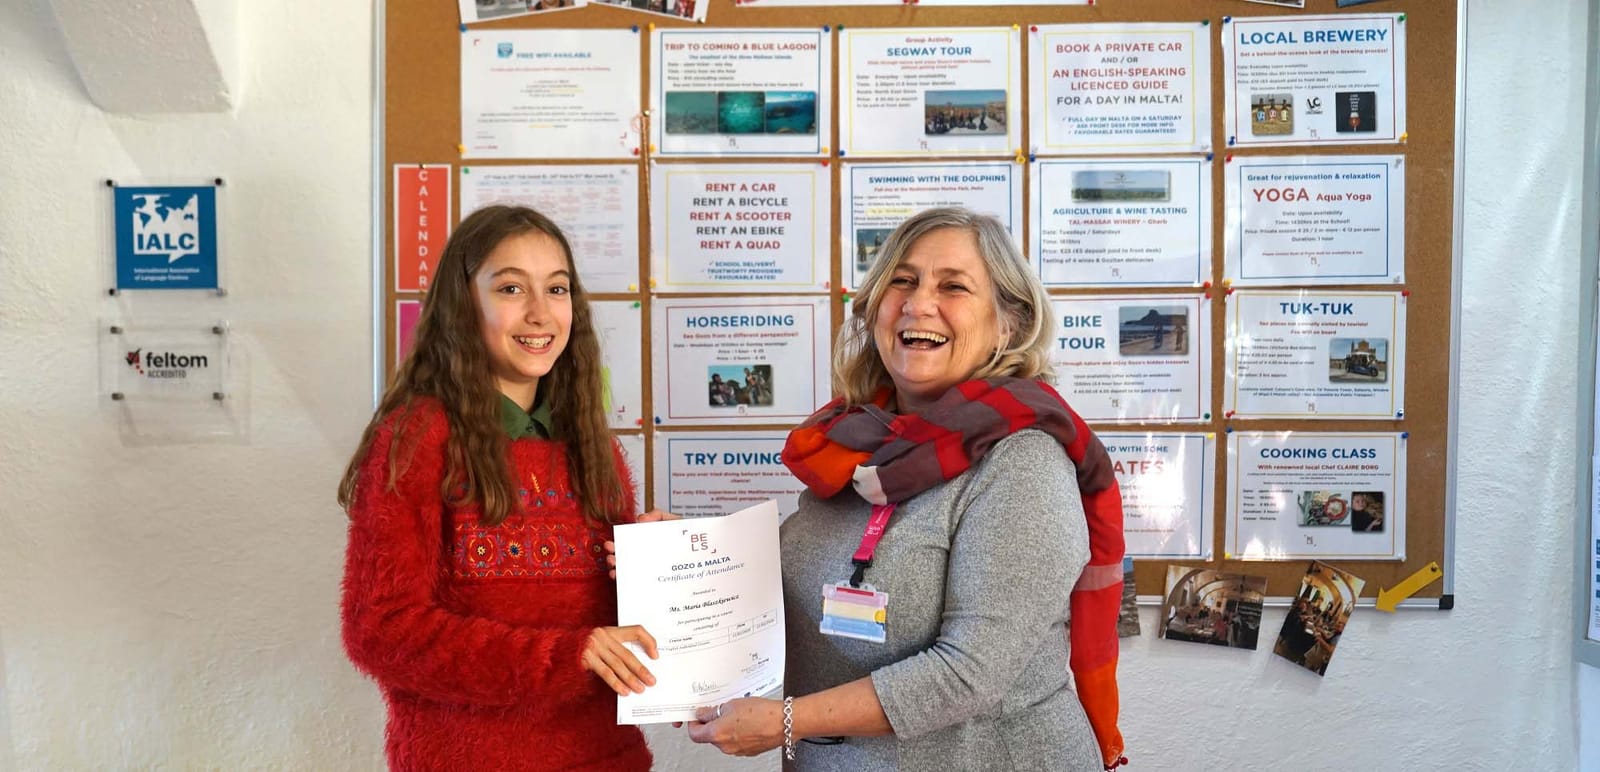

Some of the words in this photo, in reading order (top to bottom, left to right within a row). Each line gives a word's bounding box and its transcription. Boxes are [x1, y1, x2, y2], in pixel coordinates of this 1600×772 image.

[1240, 30, 1298, 45] LOCAL
[1304, 28, 1388, 44] BREWERY
[887, 47, 936, 57] SEGWAY
[941, 46, 972, 56] TOUR
[1056, 44, 1090, 53] BOOK
[1094, 43, 1102, 53] A
[1106, 43, 1155, 52] PRIVATE
[1158, 42, 1182, 52] CAR
[1053, 69, 1070, 78] AN
[1073, 67, 1186, 78] ENGLISH-SPEAKING
[1071, 80, 1128, 91] LICENCED
[1132, 80, 1168, 90] GUIDE
[1057, 96, 1080, 106] FOR
[1085, 96, 1092, 105] A
[1096, 95, 1120, 105] DAY
[1124, 95, 1135, 105] IN
[1140, 94, 1183, 104] MALTA!
[869, 176, 915, 184] SWIMMING
[943, 175, 960, 183] THE
[1247, 174, 1268, 182] Great
[1284, 173, 1332, 181] rejuvenation
[1335, 173, 1340, 181] &
[705, 183, 736, 192] RENT
[740, 183, 748, 192] A
[751, 183, 776, 192] CAR
[1253, 188, 1309, 202] YOGA
[1316, 193, 1343, 202] Aqua
[1346, 193, 1372, 202] Yoga
[693, 197, 723, 206] RENT
[727, 197, 735, 206] A
[739, 197, 788, 206] BICYCLE
[690, 212, 720, 221] RENT
[724, 212, 732, 221] A
[735, 212, 792, 221] SCOOTER
[1124, 207, 1147, 215] WINE
[418, 171, 428, 287] CALENDAR
[696, 226, 727, 235] RENT
[731, 226, 747, 235] AN
[751, 226, 785, 235] EBIKE
[137, 233, 195, 250] IALC
[700, 241, 731, 250] RENT
[735, 241, 743, 250] A
[746, 241, 781, 250] QUAD
[1280, 302, 1353, 315] TUK-TUK
[687, 314, 795, 328] HORSERIDING
[1064, 315, 1102, 327] BIKE
[1058, 337, 1106, 350] TOUR
[146, 352, 208, 368] feltom
[147, 370, 187, 378] ACCREDITED
[684, 453, 718, 465] TRY
[723, 453, 782, 465] DIVING
[1260, 448, 1327, 459] COOKING
[1332, 448, 1376, 459] CLASS
[1113, 461, 1164, 475] ATES
[690, 533, 708, 543] BE
[691, 542, 709, 552] LS
[672, 562, 695, 572] GOZO
[705, 556, 731, 567] MALTA
[657, 572, 695, 584] Certificate
[706, 562, 745, 577] Attendance
